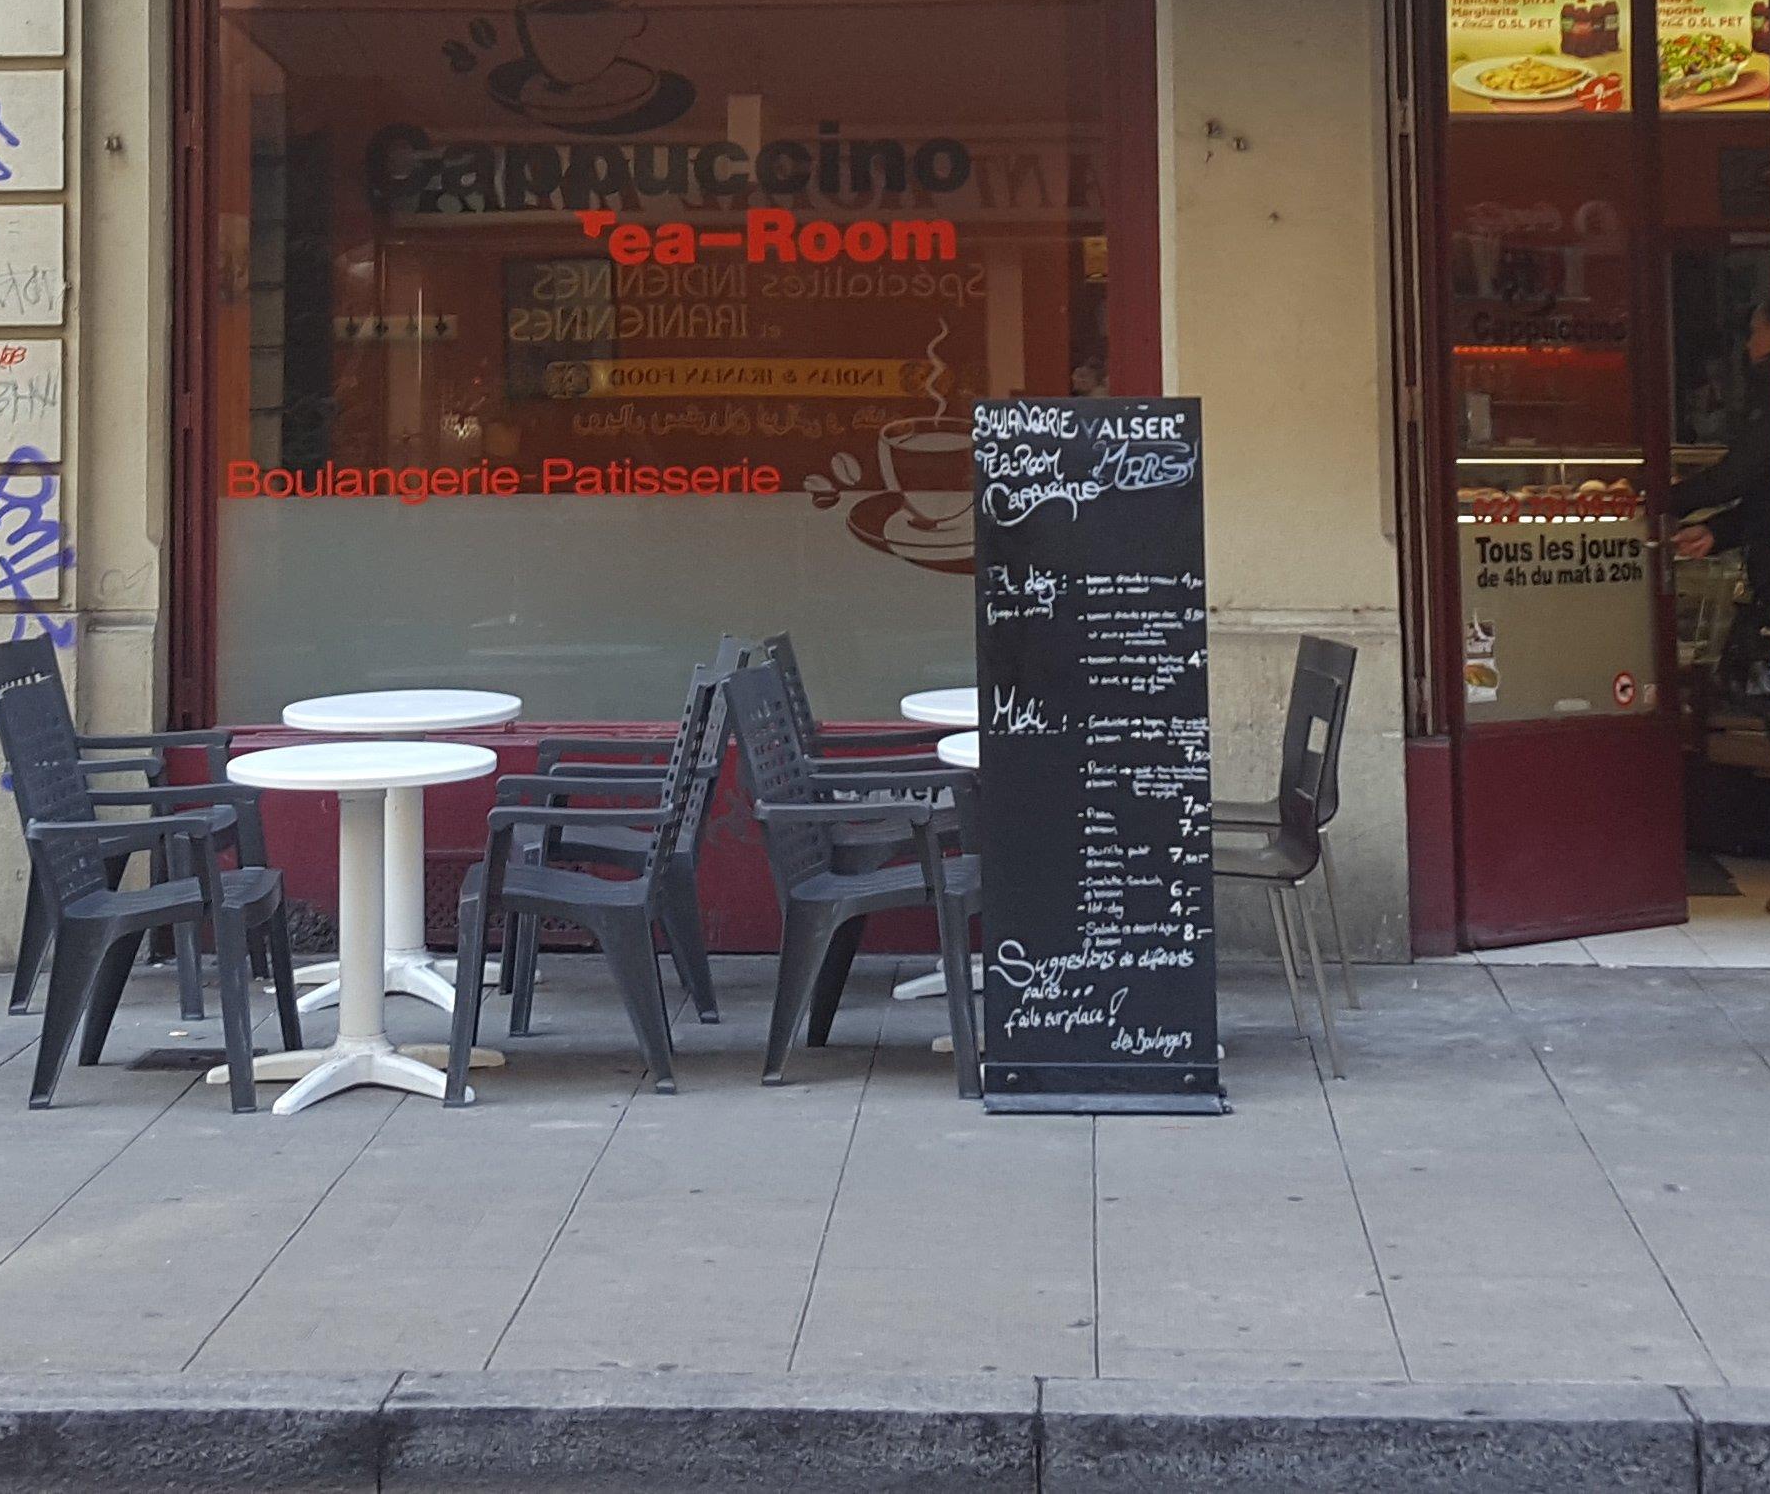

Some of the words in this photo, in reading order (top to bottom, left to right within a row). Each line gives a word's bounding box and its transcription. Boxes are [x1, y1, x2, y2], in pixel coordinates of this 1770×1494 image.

[367, 120, 972, 210] Cappuccino
[1475, 536, 1533, 564] Tous
[1540, 534, 1574, 562] les
[1580, 532, 1642, 565] jours
[1477, 568, 1499, 588] de
[1503, 567, 1527, 586] 4h
[1531, 565, 1554, 586] du
[1557, 562, 1592, 585] mat
[1596, 562, 1605, 583] à
[1609, 562, 1643, 583] 20h
